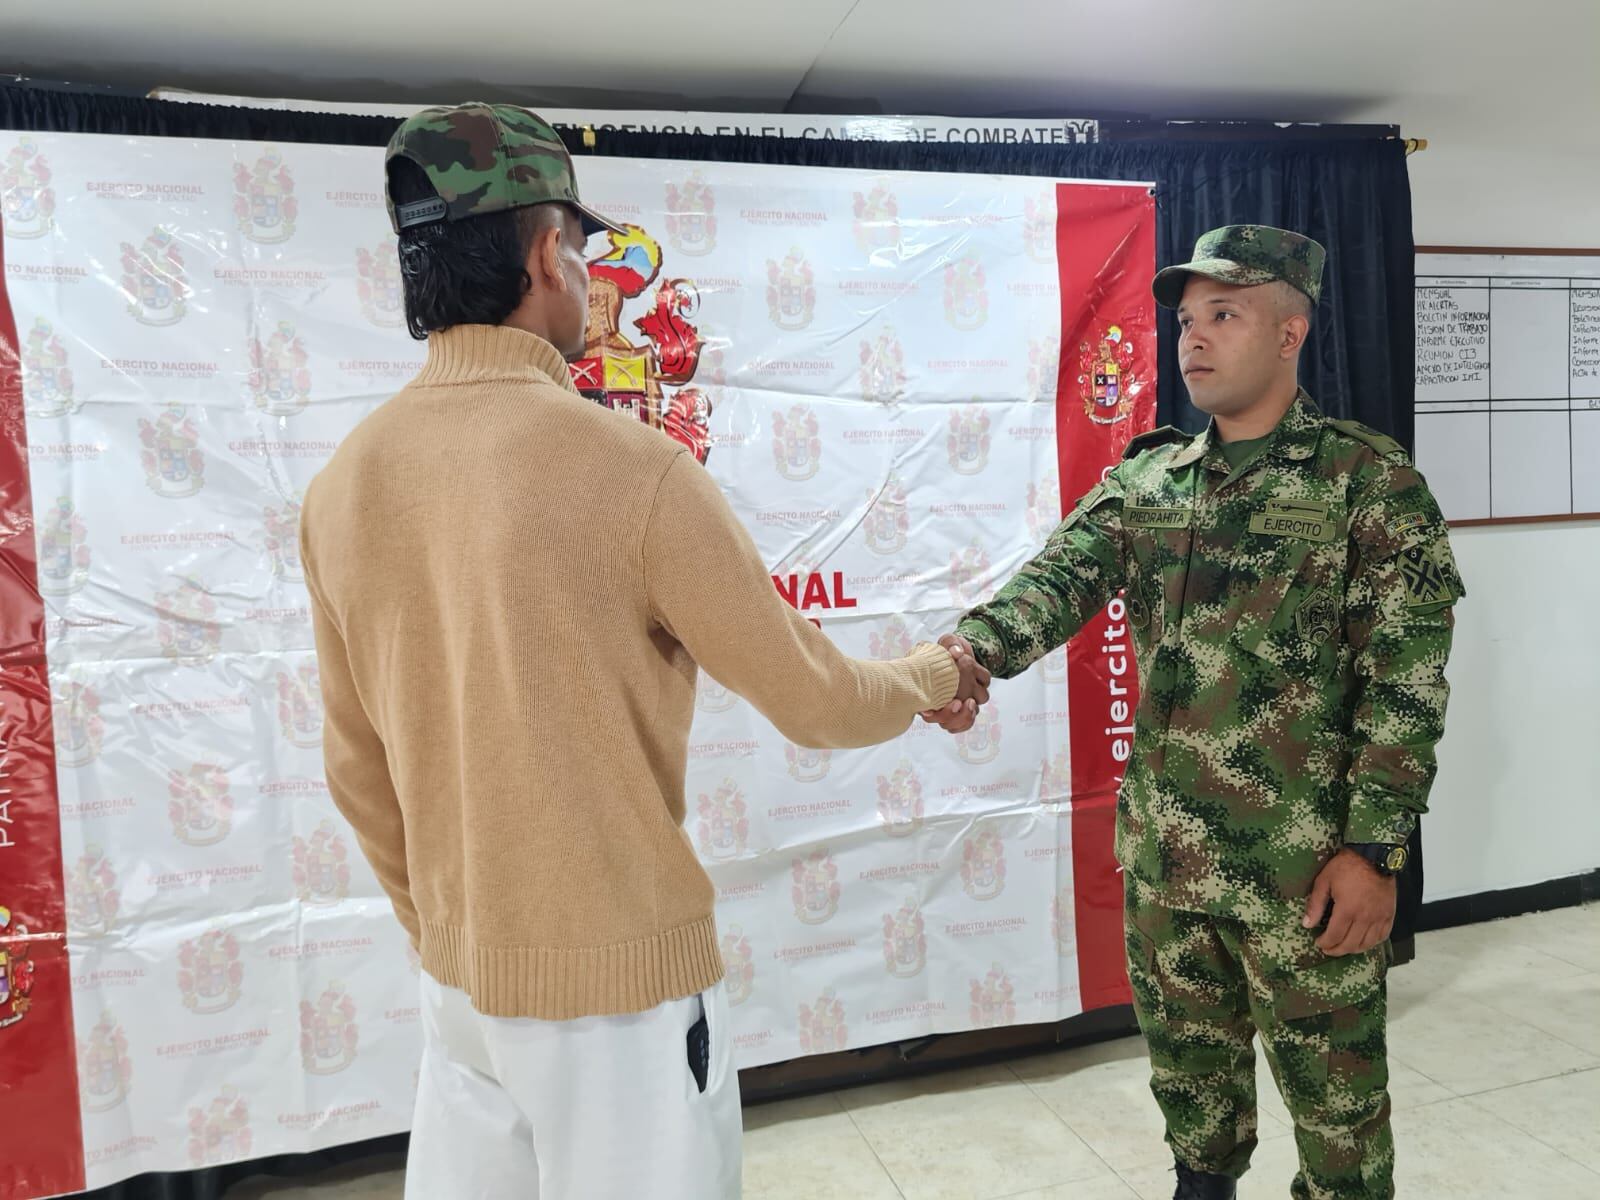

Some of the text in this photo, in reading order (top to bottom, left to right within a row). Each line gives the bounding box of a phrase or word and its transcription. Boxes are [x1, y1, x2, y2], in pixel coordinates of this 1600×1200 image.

[946, 127, 1063, 144] COMBATE
[146, 184, 206, 195] NACIONAL
[25, 264, 88, 277] NACIONAL
[1129, 510, 1185, 525] PIEDRAHITA
[1263, 517, 1323, 538] EJERCITO
